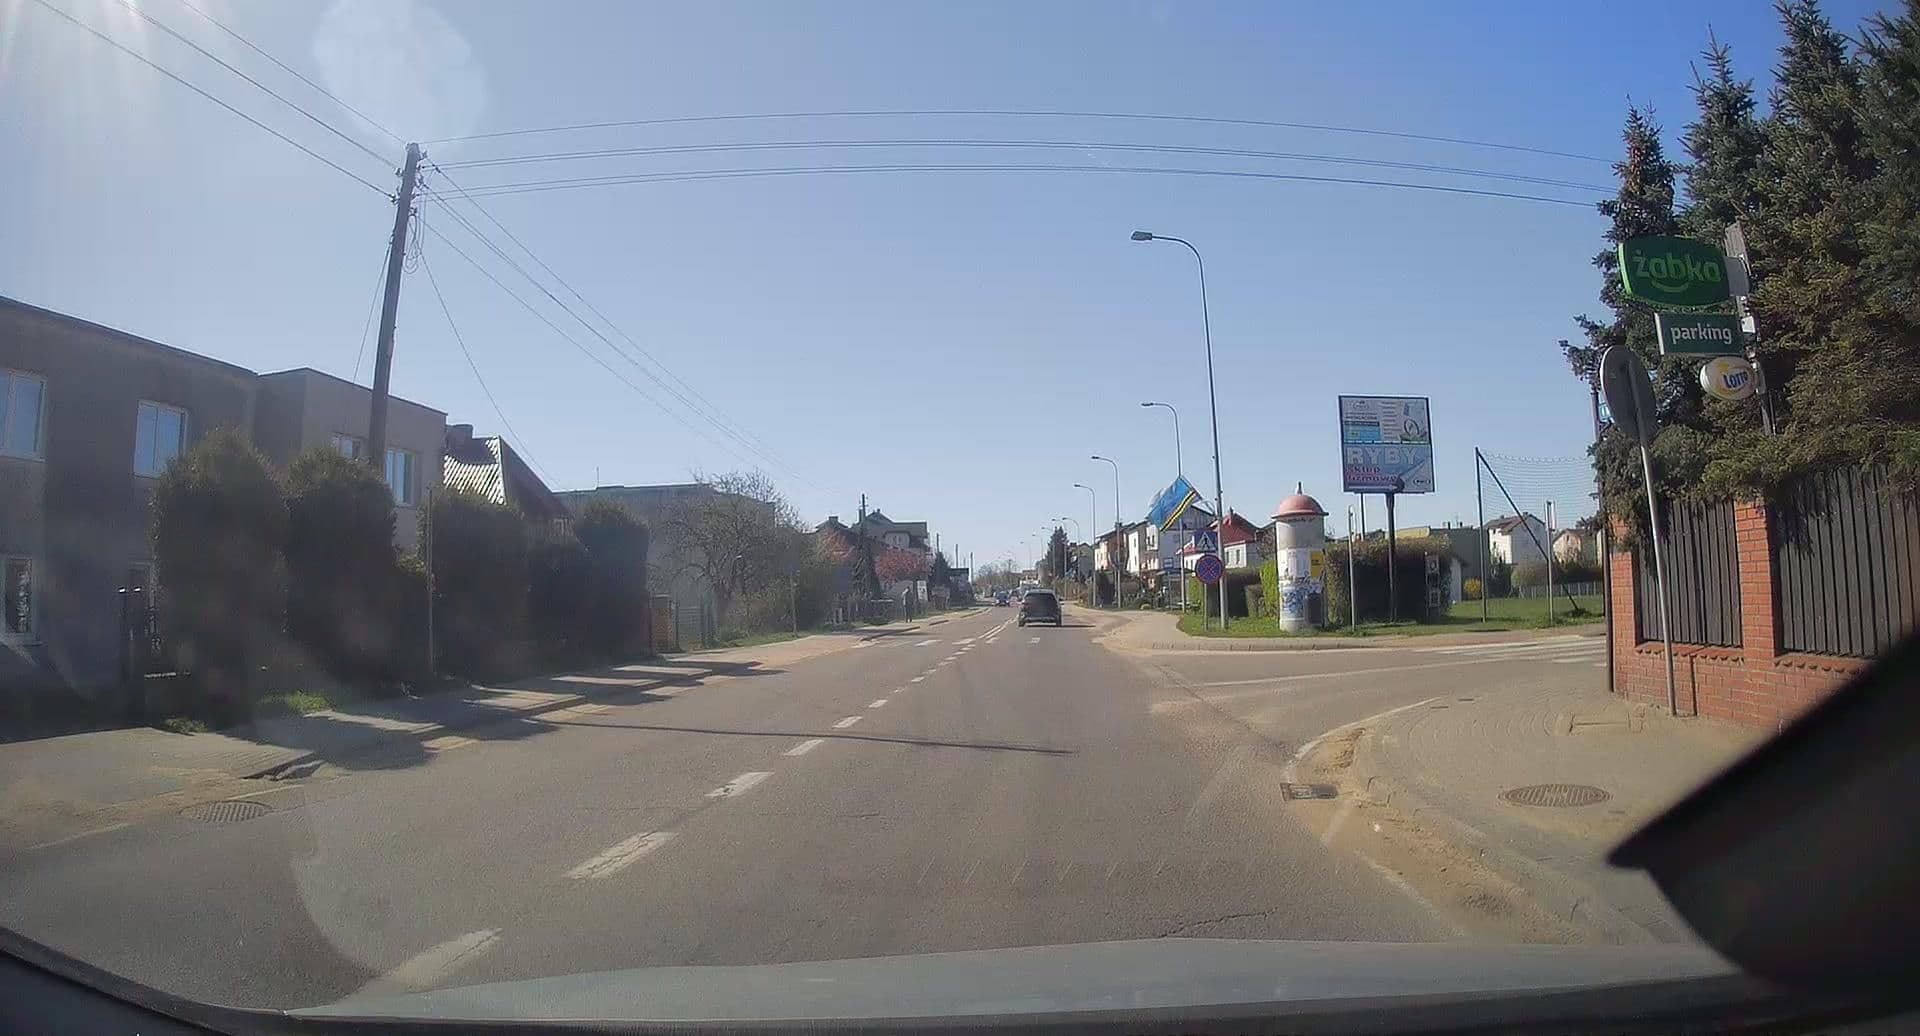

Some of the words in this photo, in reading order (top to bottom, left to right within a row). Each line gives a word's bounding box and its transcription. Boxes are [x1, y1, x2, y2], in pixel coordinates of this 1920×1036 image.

[1631, 251, 1721, 282] żabka
[1670, 322, 1733, 346] parking
[1347, 447, 1416, 465] RYBY
